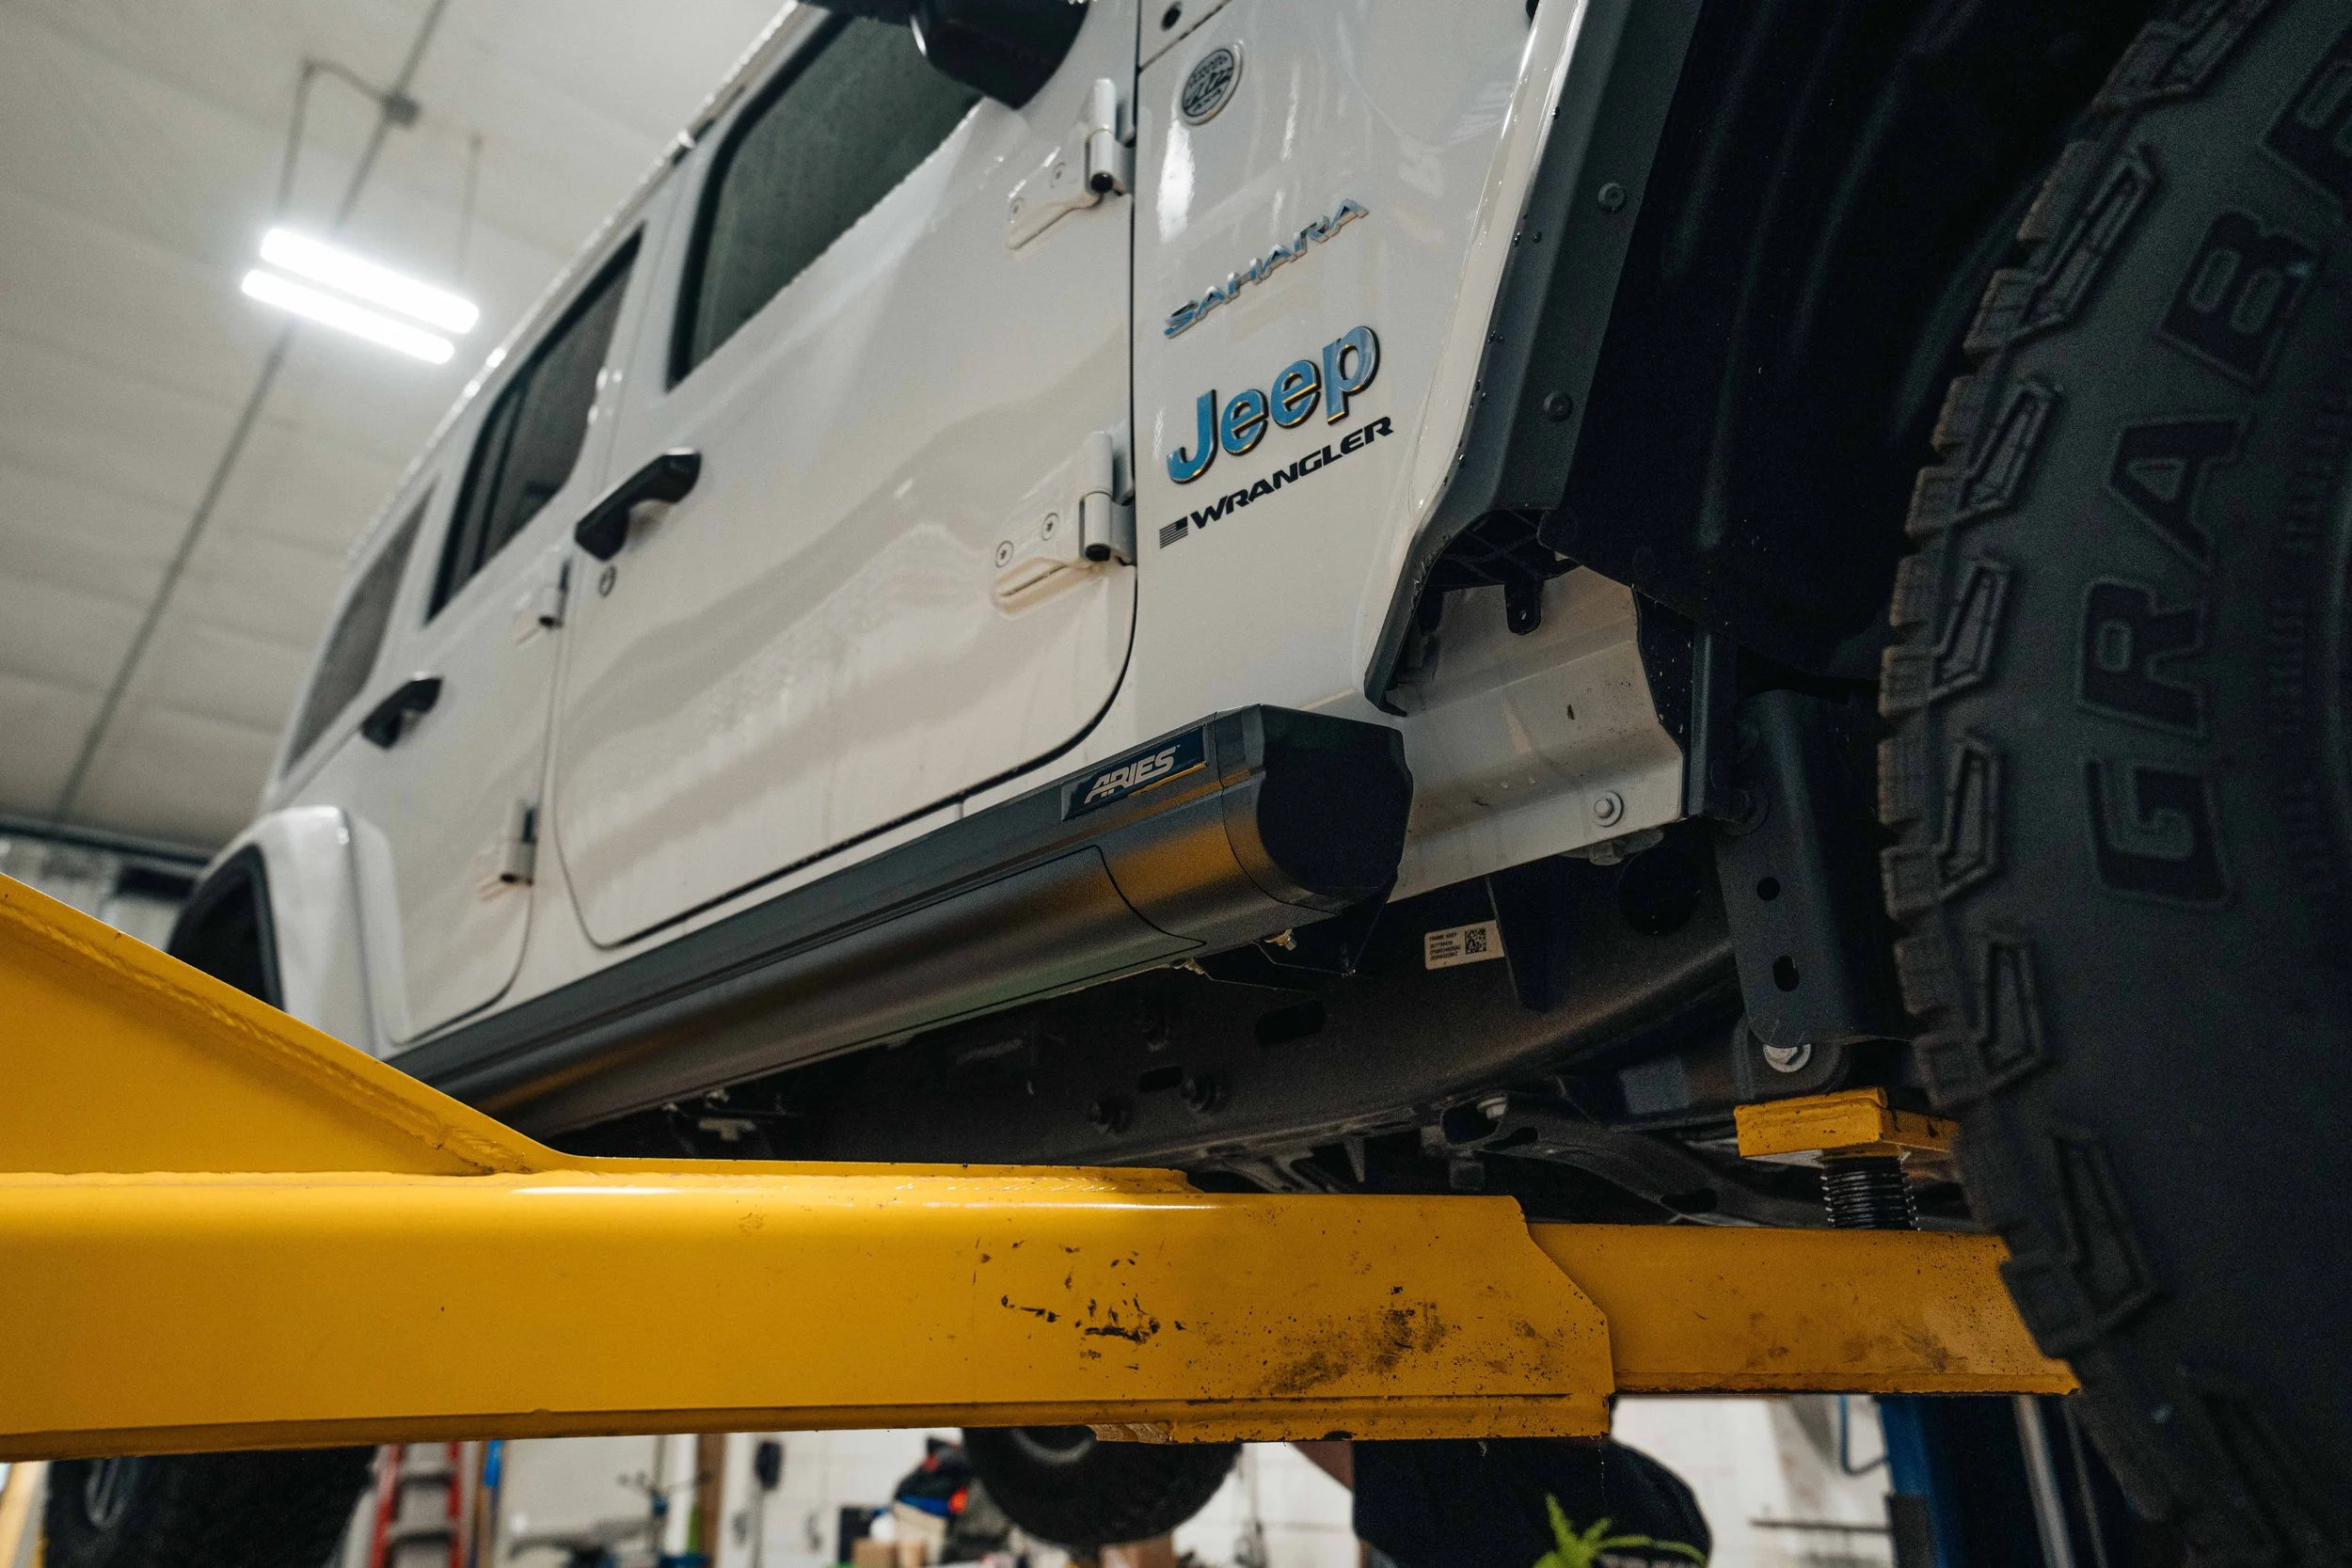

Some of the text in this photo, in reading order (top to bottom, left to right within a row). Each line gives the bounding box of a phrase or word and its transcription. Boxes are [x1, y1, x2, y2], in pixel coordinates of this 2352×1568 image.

[1164, 198, 1370, 339] SAHARA
[1167, 326, 1380, 484] Jeep
[1190, 416, 1394, 530] WRANGLER
[1084, 745, 1177, 804] ARIES
